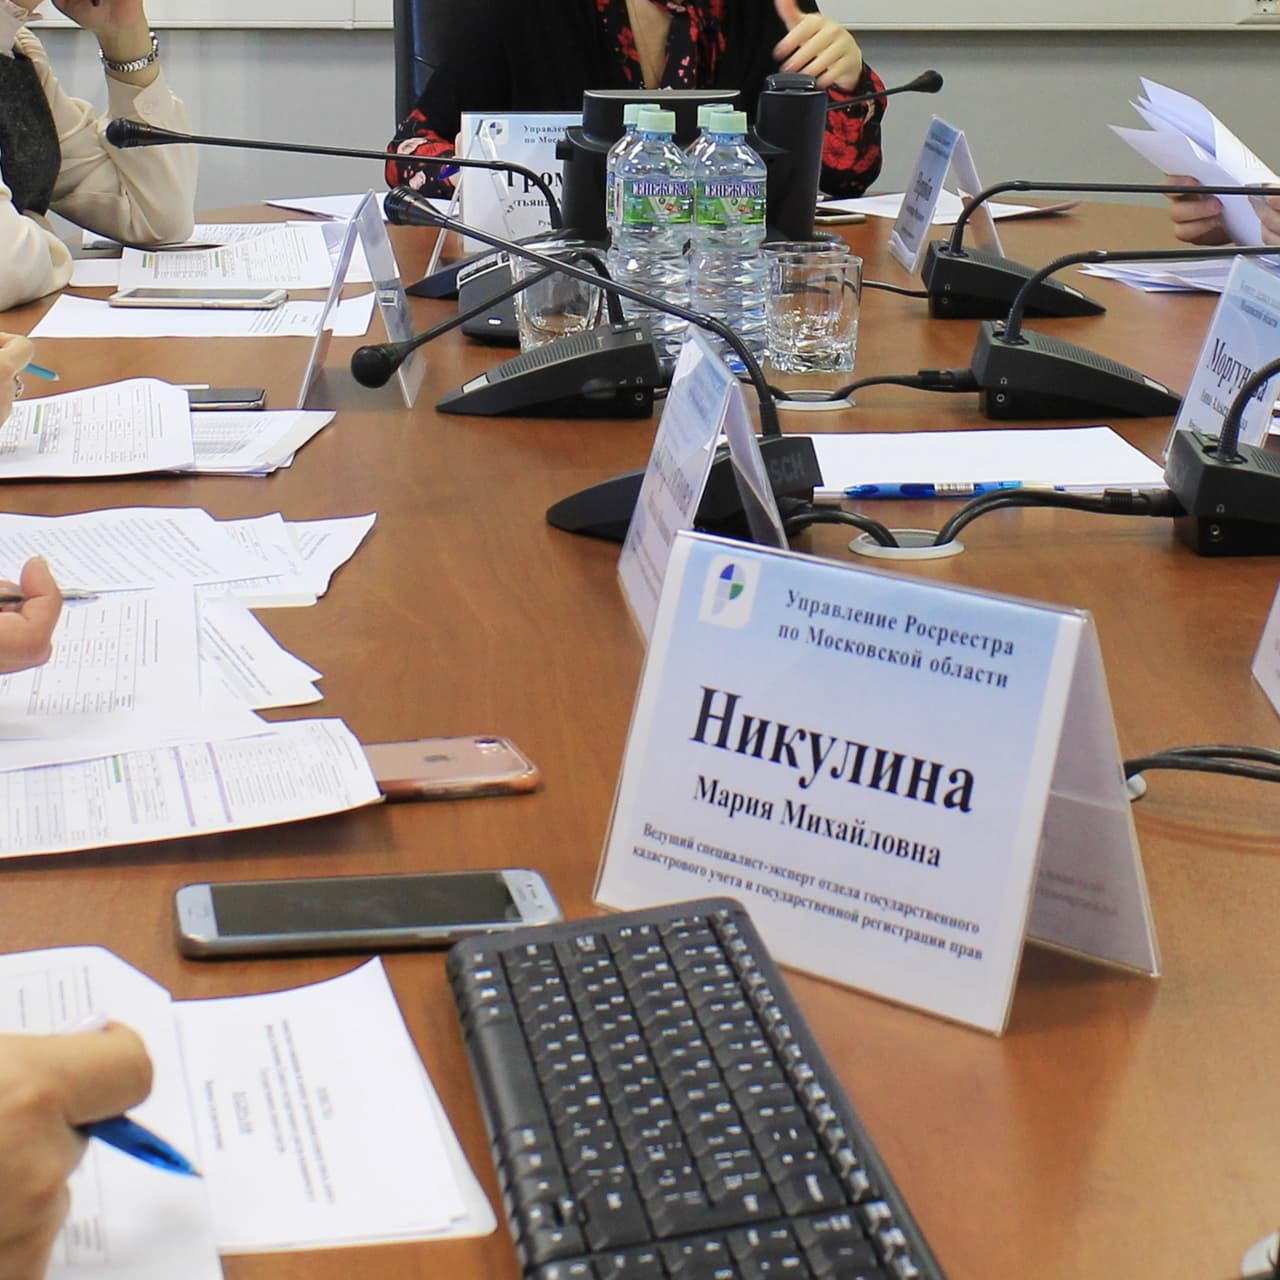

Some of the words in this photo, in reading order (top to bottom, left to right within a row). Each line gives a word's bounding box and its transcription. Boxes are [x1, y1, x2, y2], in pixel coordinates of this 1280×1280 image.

[1207, 338, 1269, 402] Моргуна
[770, 452, 806, 484] SCH
[778, 625, 799, 640] по
[807, 626, 922, 669] Московской
[930, 656, 1008, 688] области
[786, 589, 897, 630] Управление
[904, 615, 1014, 658] Росреестра
[690, 686, 974, 813] Никулина
[694, 775, 773, 820] Мария
[781, 800, 940, 867] Михайловна
[633, 846, 707, 876] кадастрового
[708, 869, 742, 888] учета
[756, 883, 859, 923] государственной
[861, 916, 946, 949] регистрации
[949, 942, 983, 960] прав
[643, 822, 694, 850] Ведущий
[818, 879, 860, 900] отдела
[864, 892, 980, 934] государственного
